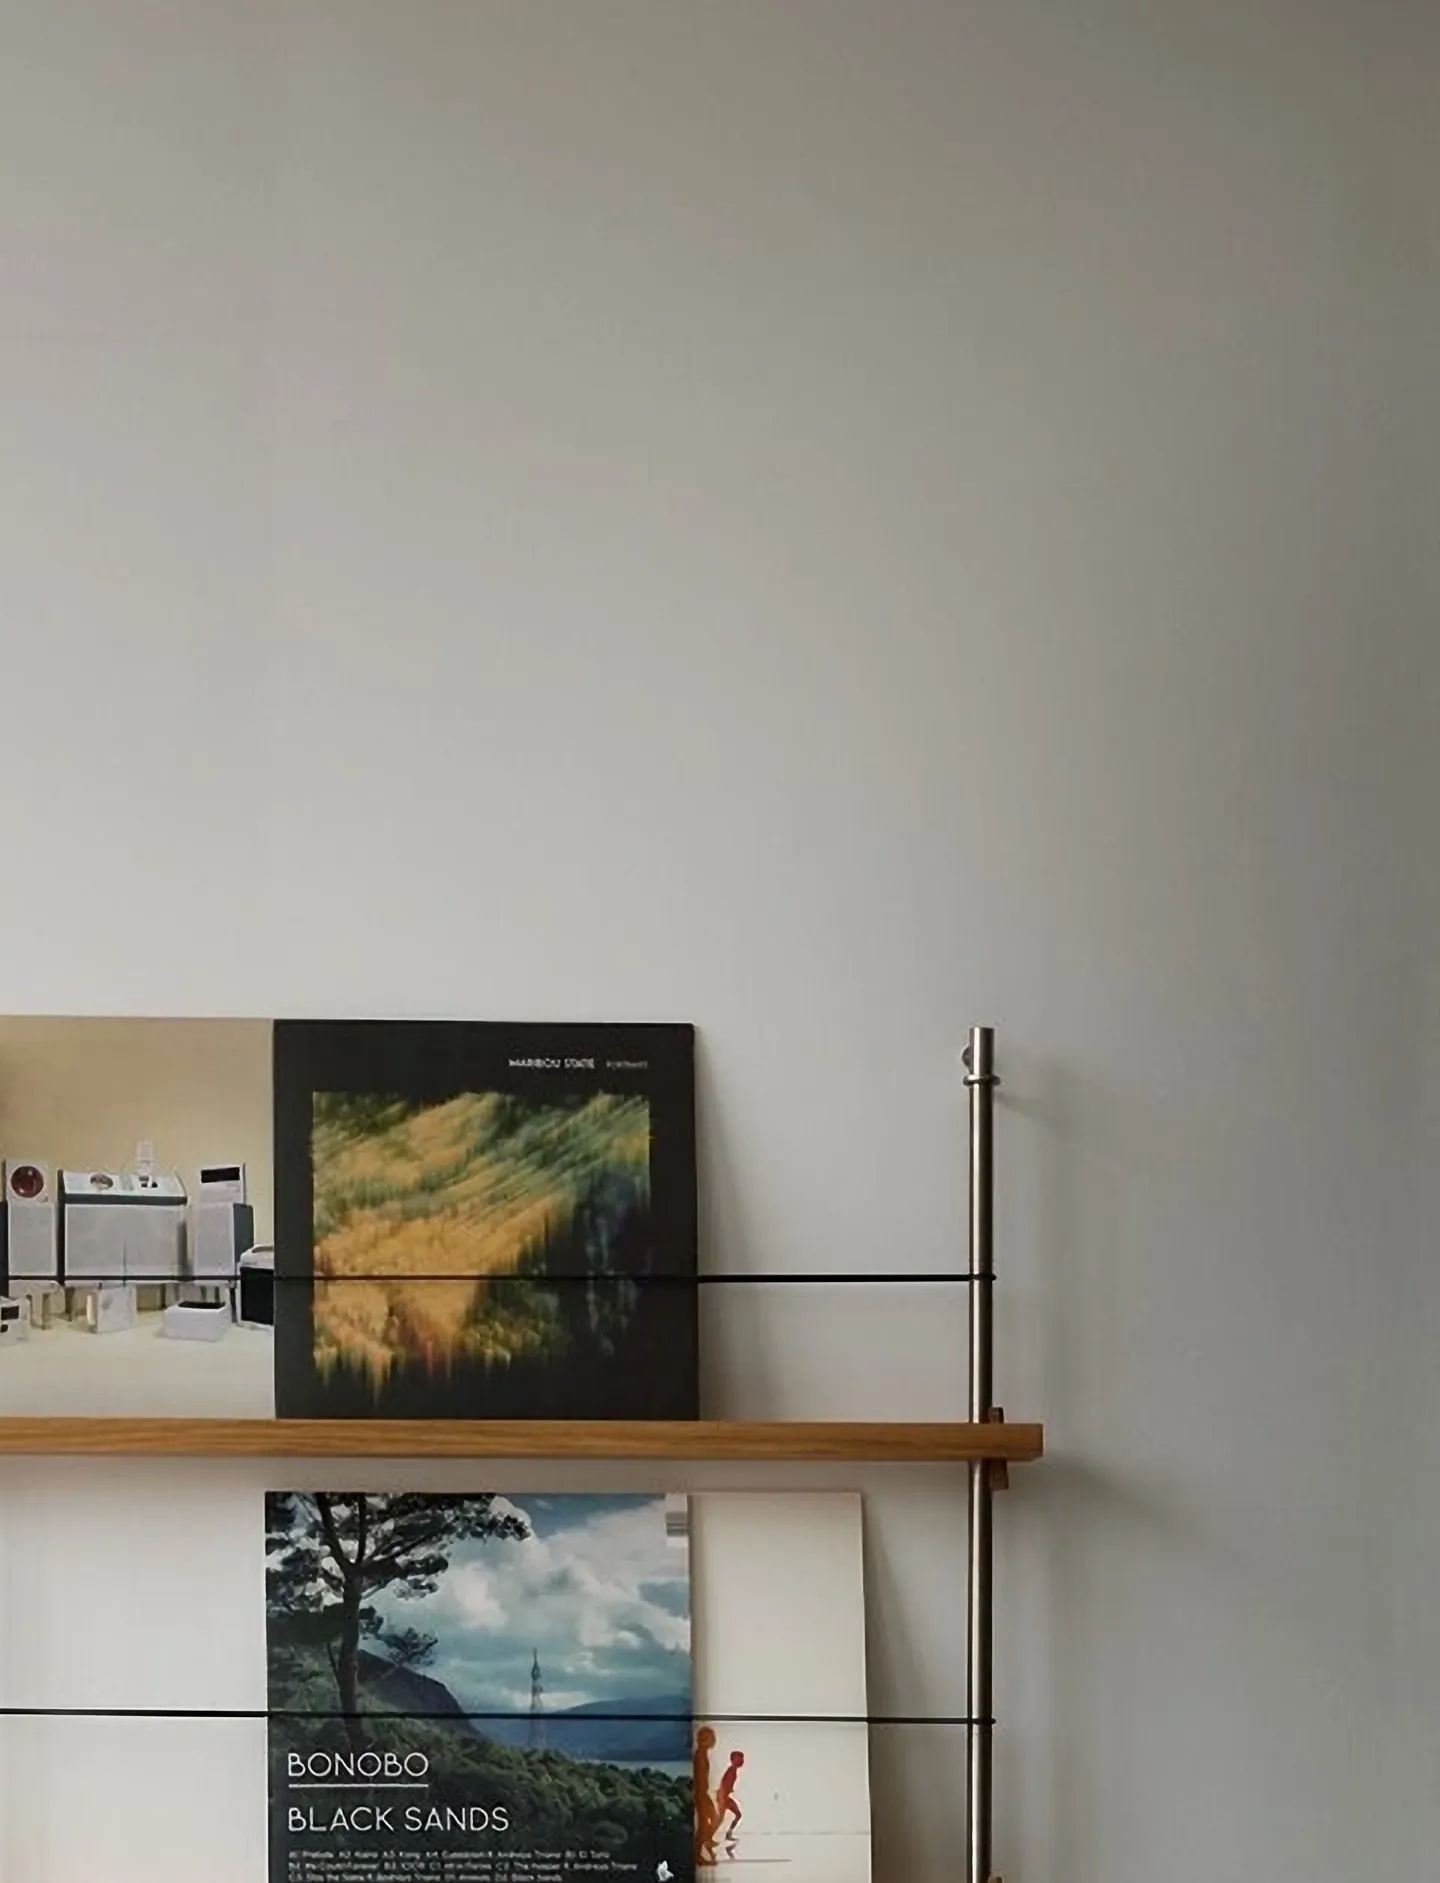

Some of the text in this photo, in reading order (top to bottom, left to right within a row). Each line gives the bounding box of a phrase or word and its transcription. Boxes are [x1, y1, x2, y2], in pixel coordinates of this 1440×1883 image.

[287, 1752, 429, 1777] BONOBO
[288, 1806, 509, 1832] BLACK SANDS
